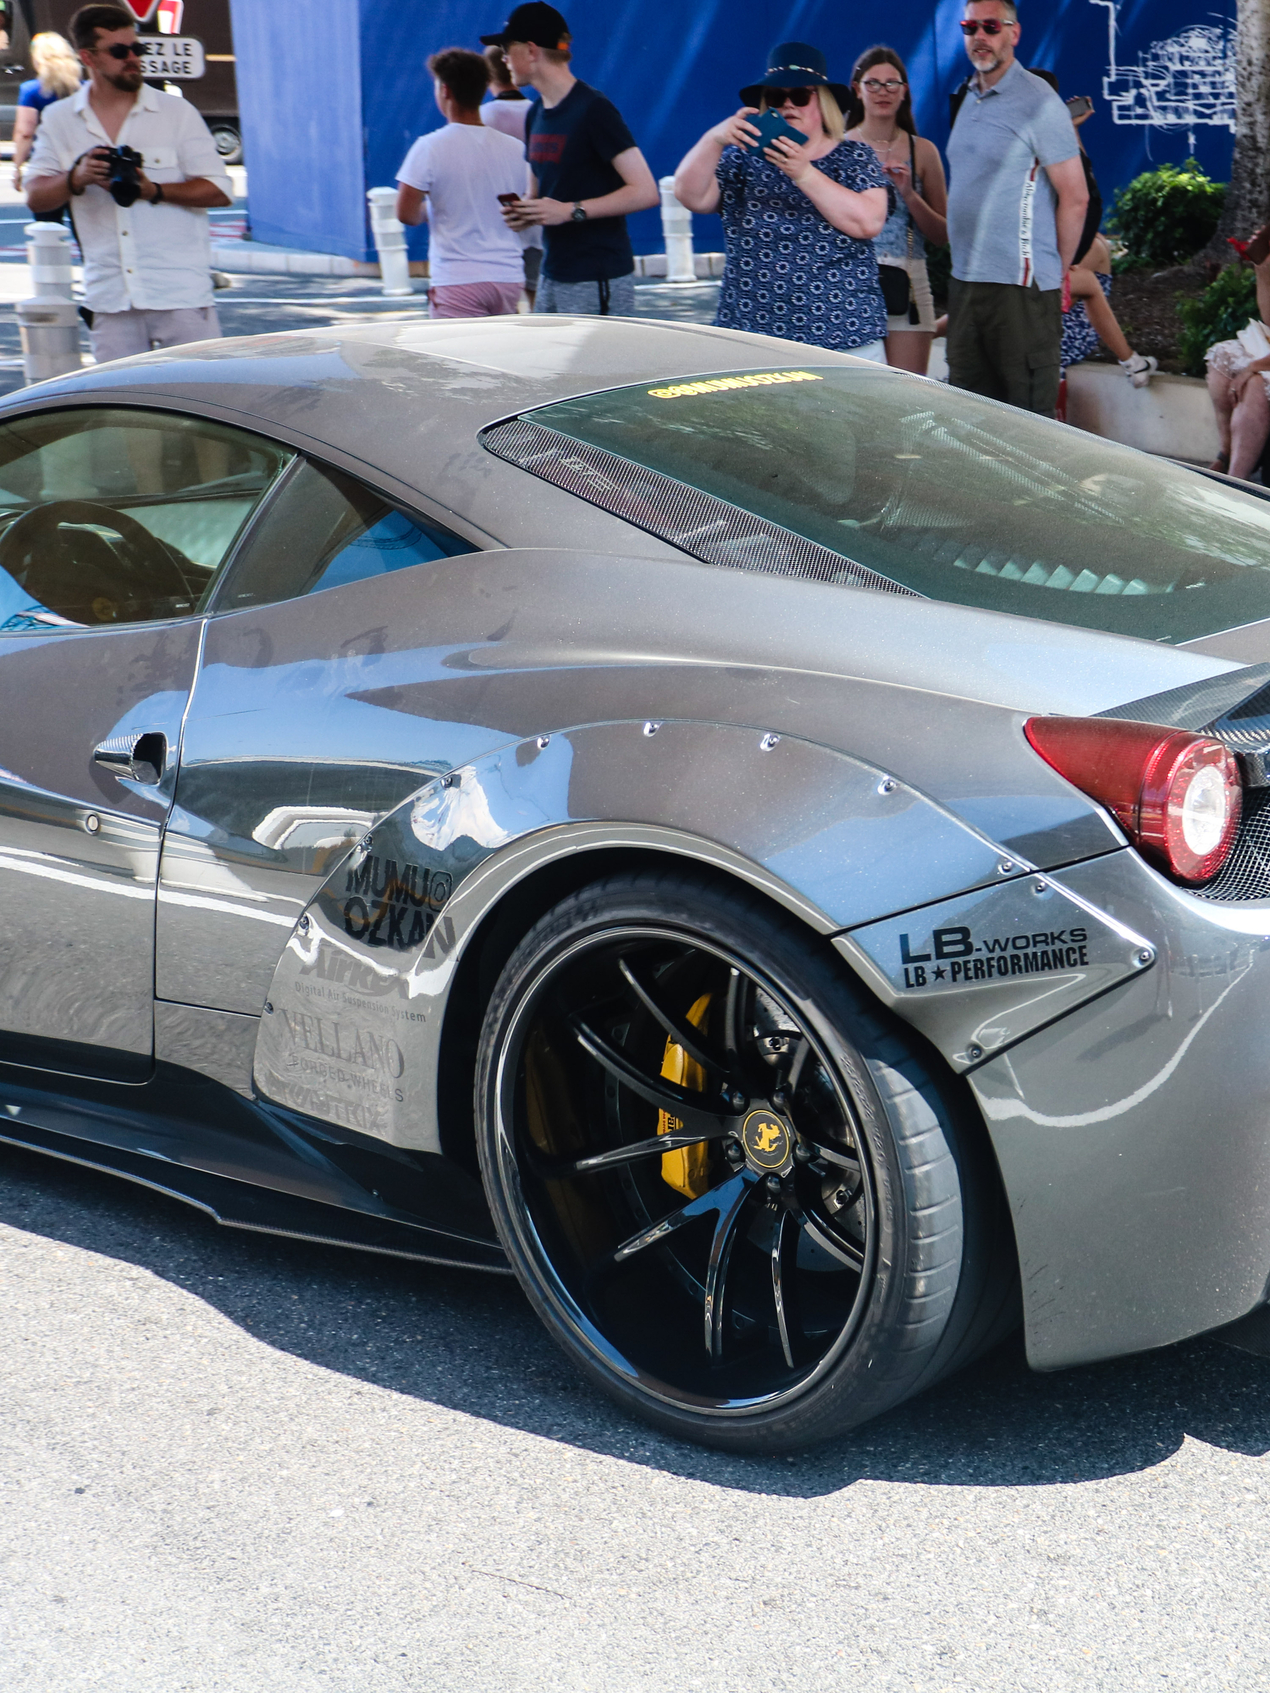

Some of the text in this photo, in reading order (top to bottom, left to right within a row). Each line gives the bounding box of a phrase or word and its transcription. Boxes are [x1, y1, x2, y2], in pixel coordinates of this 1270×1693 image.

[140, 60, 193, 75] SSAGE
[172, 43, 193, 57] LE
[343, 896, 456, 960] OZKAN
[904, 945, 1090, 989] LB PERFORMANCE
[294, 980, 427, 1023] Digital Air Suspension System
[279, 1008, 405, 1079] VELLANO
